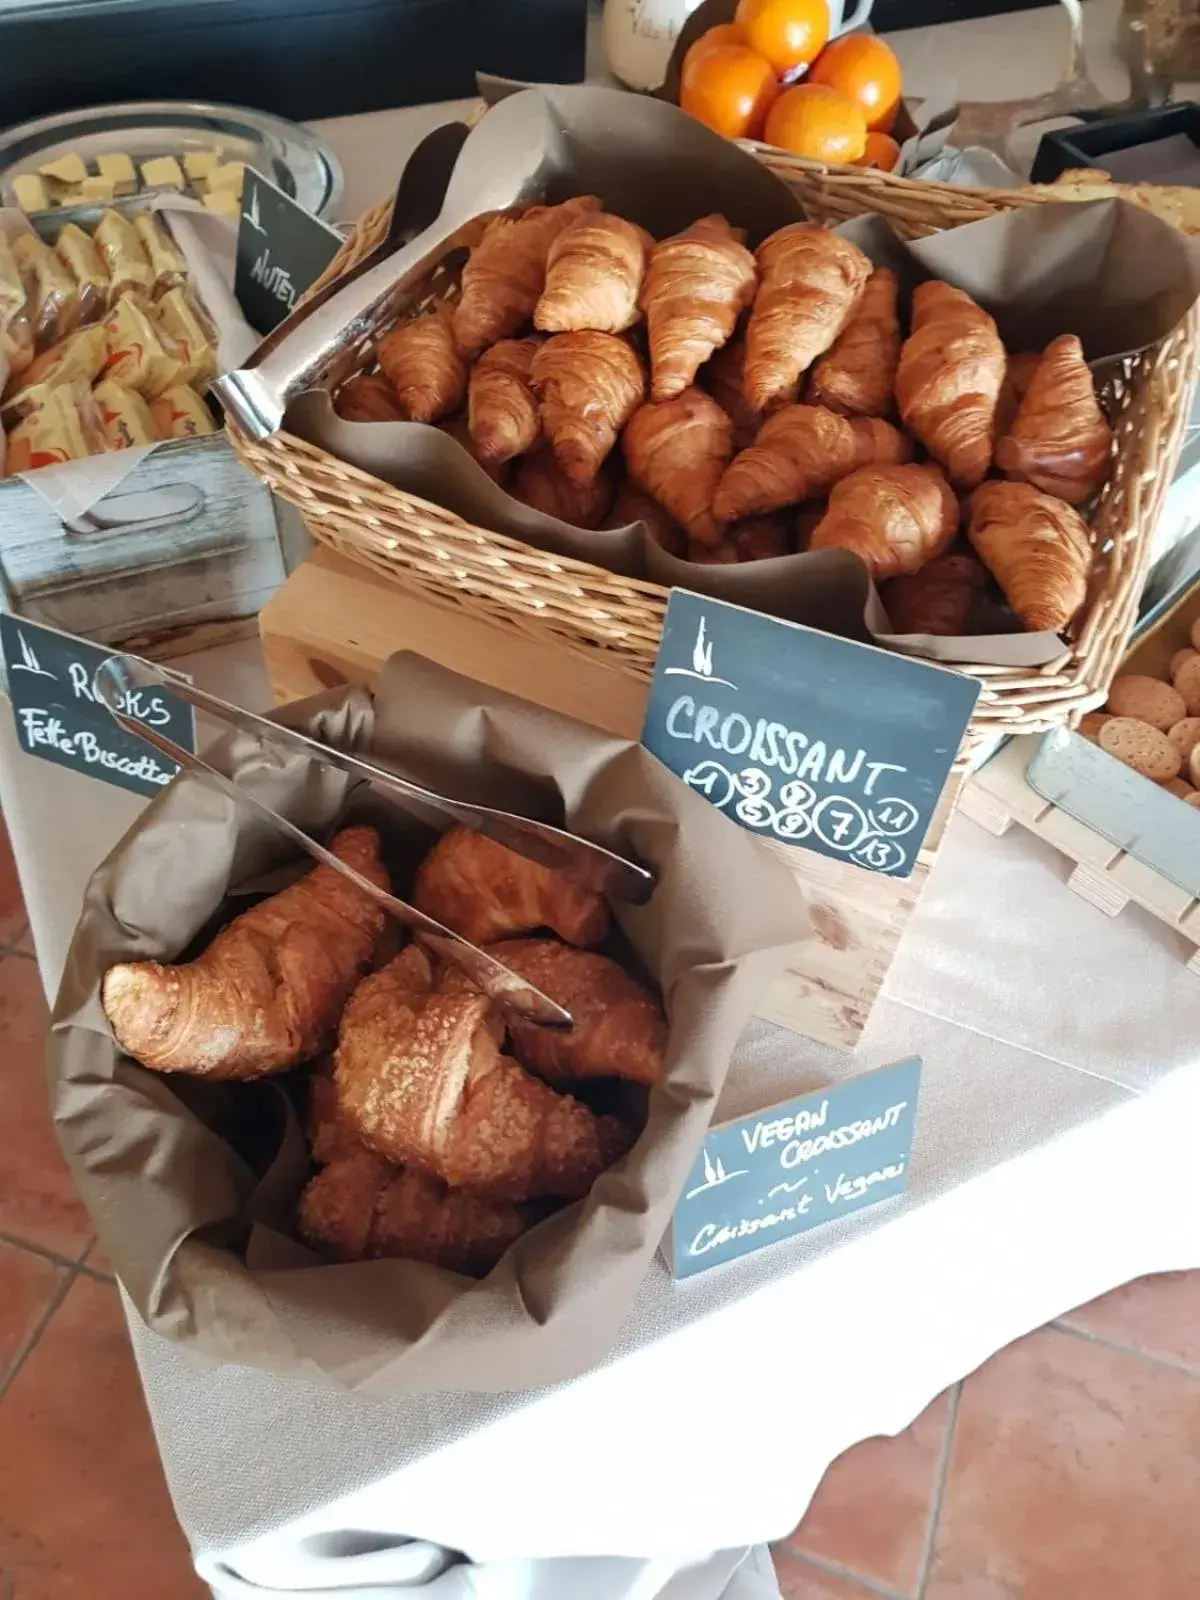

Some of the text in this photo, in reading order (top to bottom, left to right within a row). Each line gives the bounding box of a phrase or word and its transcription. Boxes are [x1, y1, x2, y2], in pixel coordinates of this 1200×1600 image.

[68, 662, 171, 726] RKS
[18, 707, 181, 786] Fette Biscotta
[665, 695, 908, 796] CROISSANT
[741, 1100, 830, 1154] VEGAN
[780, 1101, 908, 1169] CROISSANT
[824, 1152, 905, 1204] Vegani
